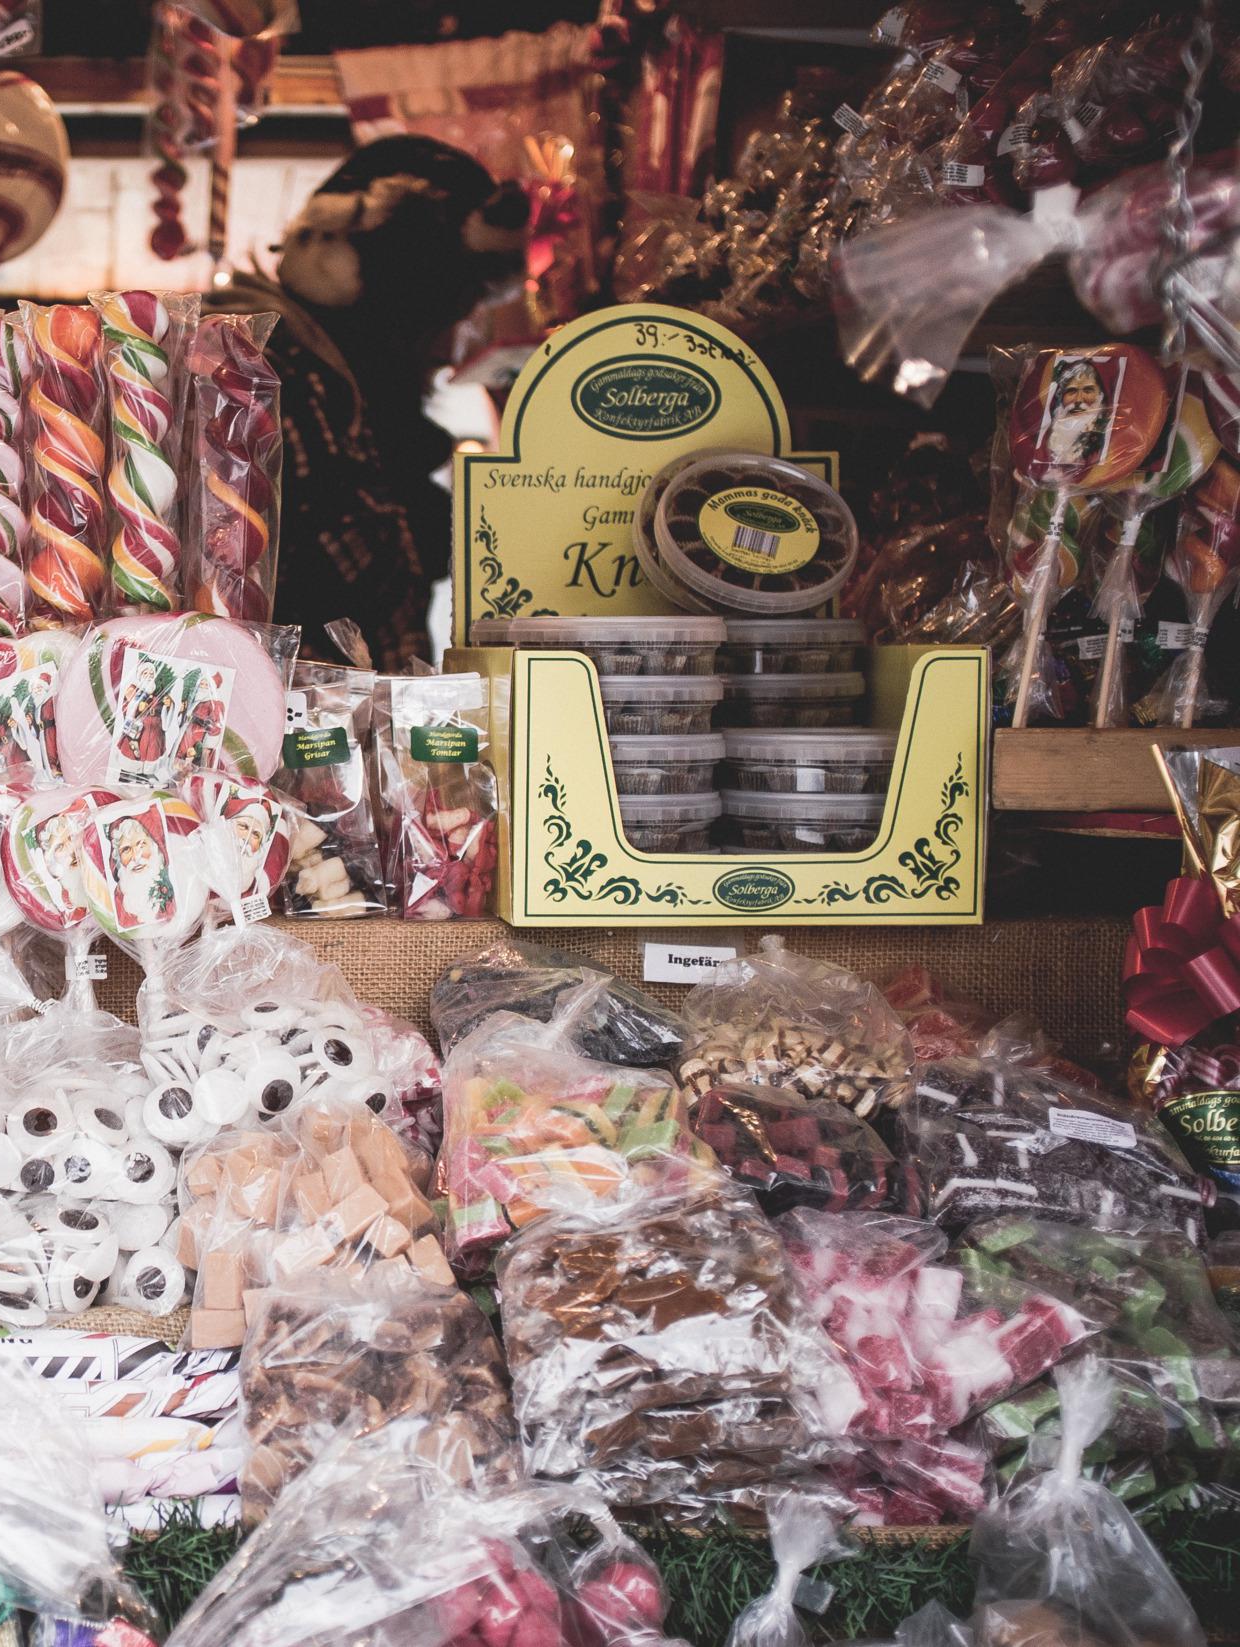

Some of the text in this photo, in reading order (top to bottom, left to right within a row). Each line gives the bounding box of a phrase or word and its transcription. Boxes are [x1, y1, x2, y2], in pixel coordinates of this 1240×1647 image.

[590, 366, 646, 393] Gammaldags
[601, 385, 689, 415] Solberga
[484, 467, 568, 493] Svenska
[707, 489, 818, 534] Mammas goda knäck
[296, 739, 336, 751] Marsipan
[304, 749, 331, 760] Grisar
[425, 739, 466, 749] Marsipan
[431, 748, 462, 757] Tomtar
[728, 883, 778, 899] Solberga
[1181, 1109, 1239, 1136] Solbe
